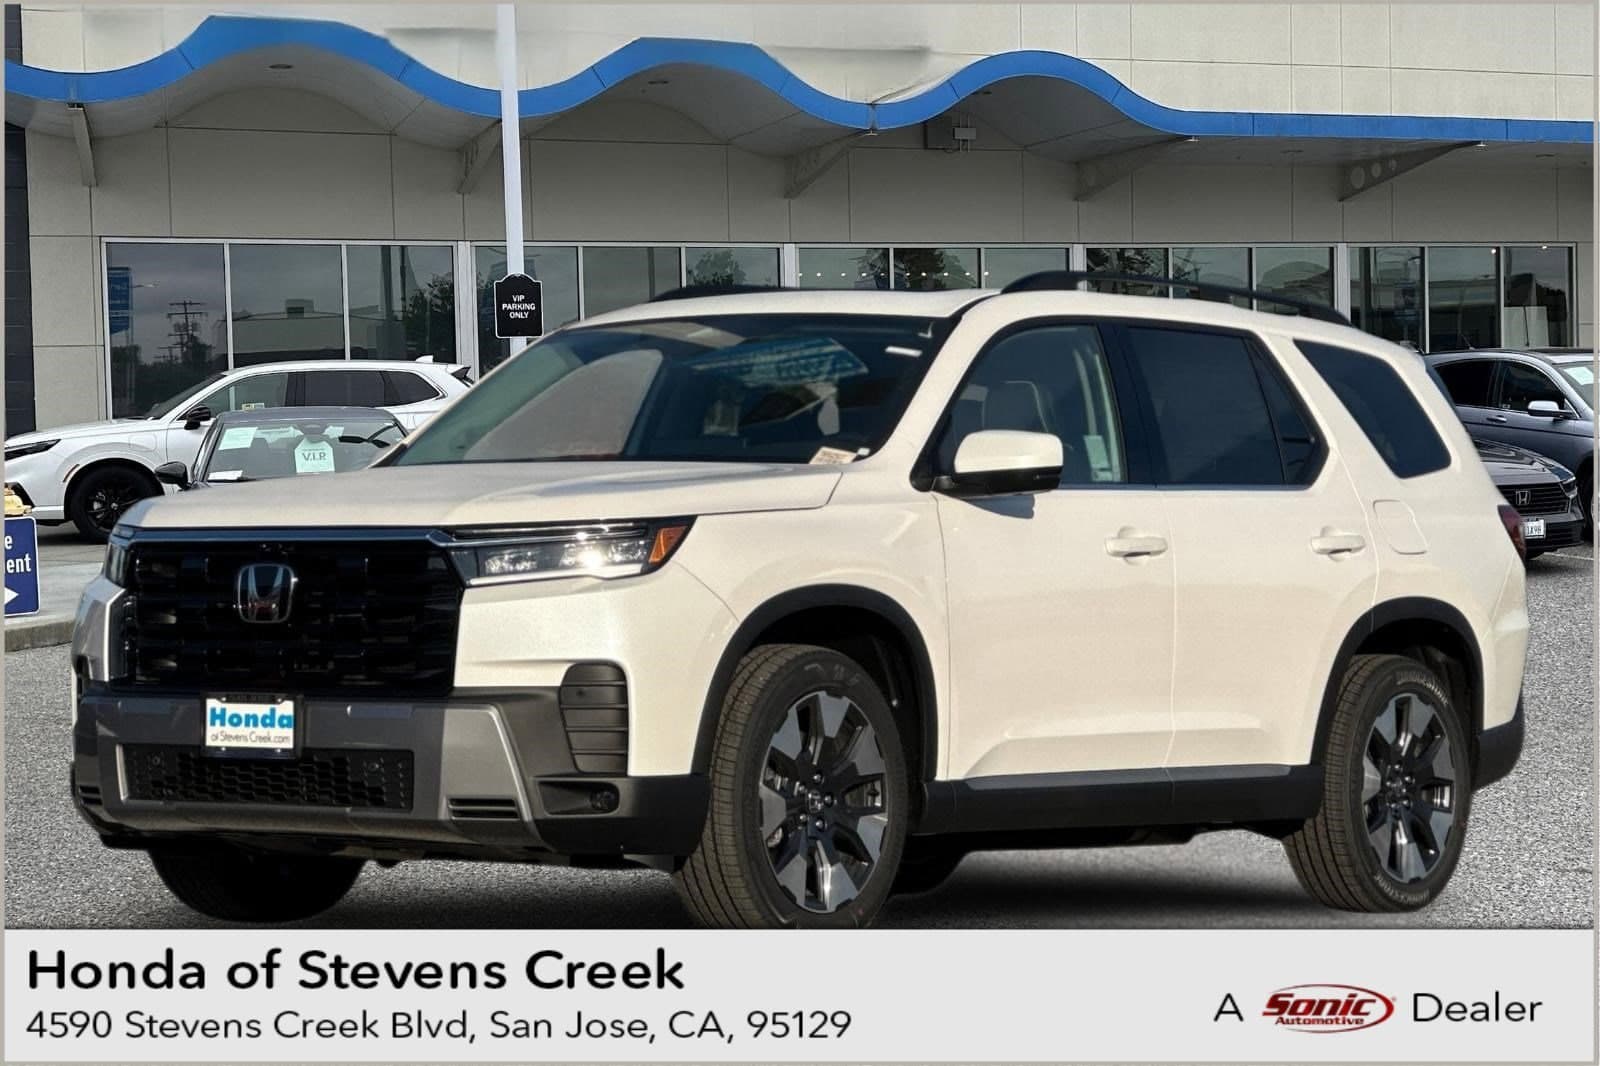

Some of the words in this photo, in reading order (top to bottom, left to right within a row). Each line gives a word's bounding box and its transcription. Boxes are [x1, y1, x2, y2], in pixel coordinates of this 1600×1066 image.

[502, 303, 536, 311] PARKING
[509, 311, 529, 319] ONLY
[210, 707, 293, 728] Honda
